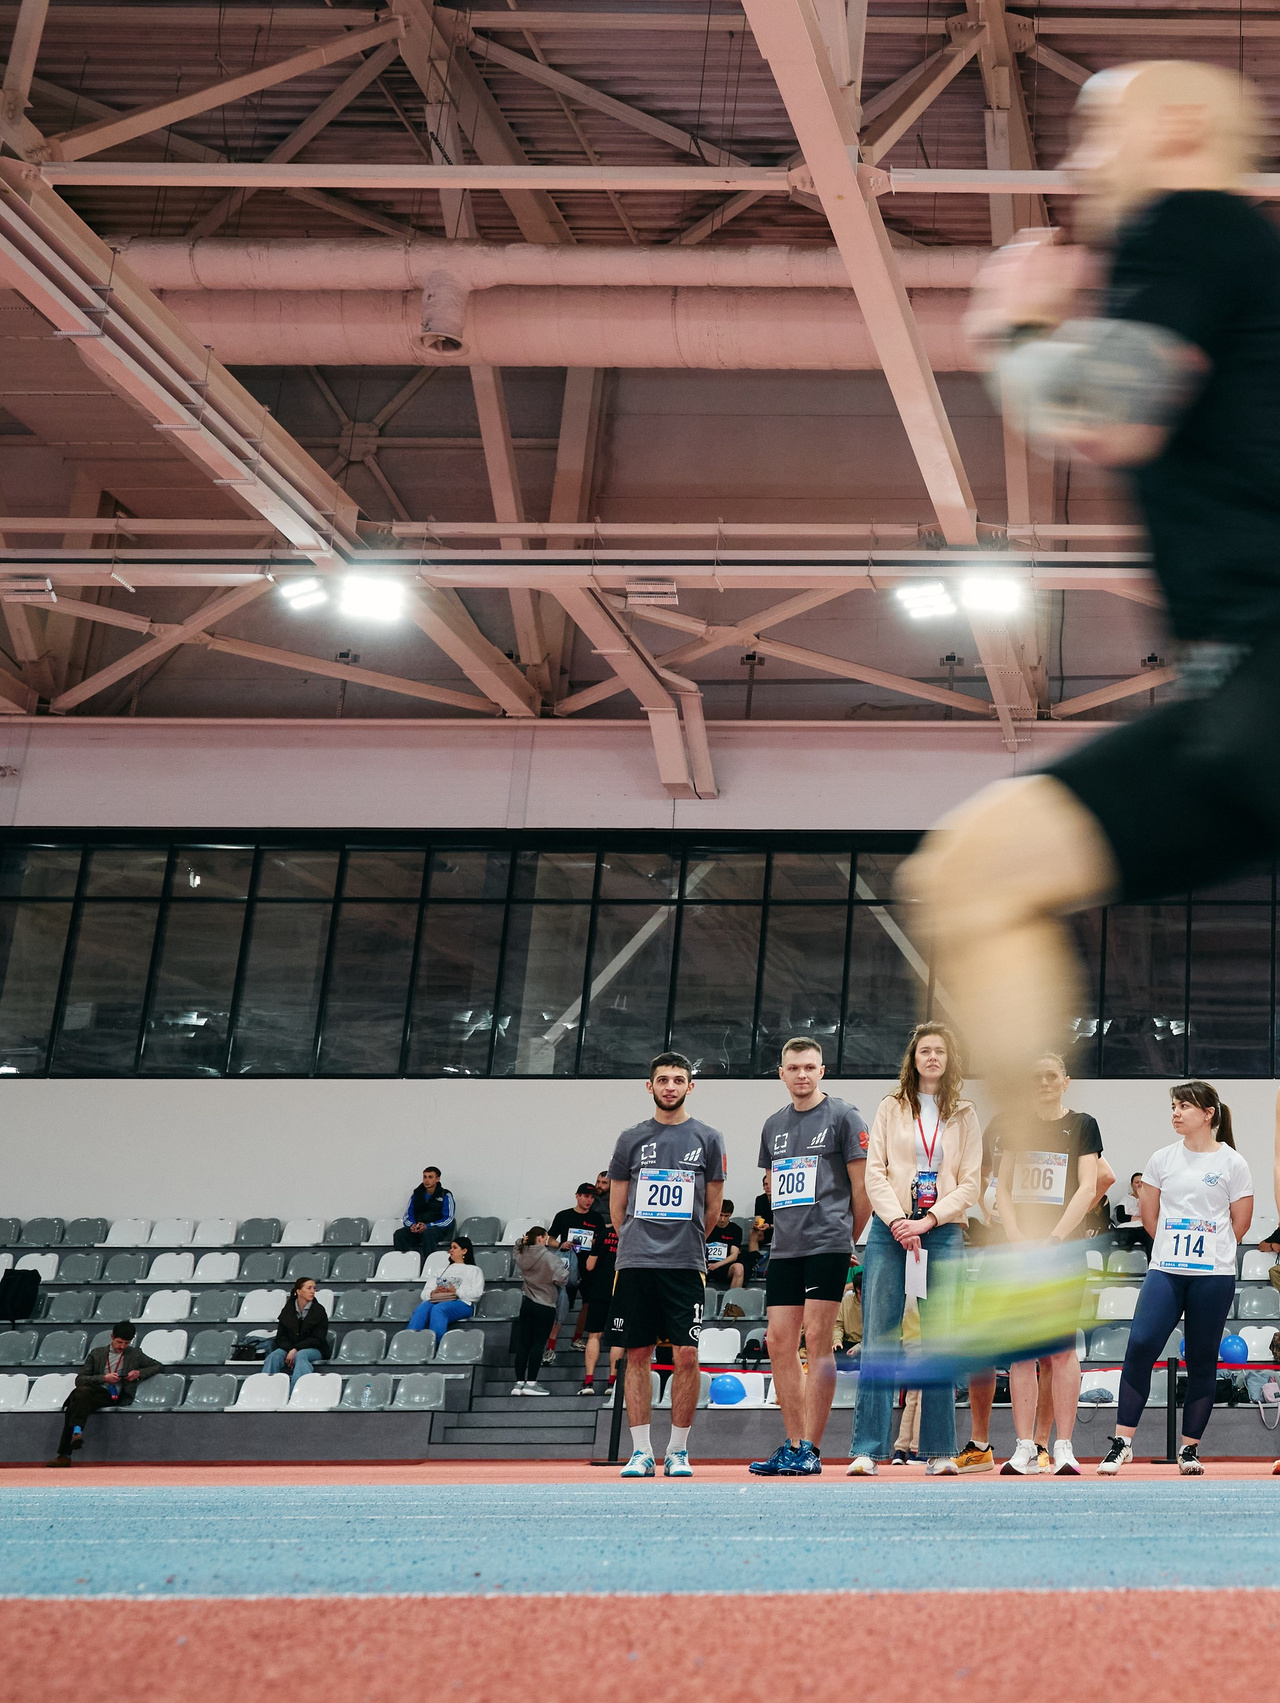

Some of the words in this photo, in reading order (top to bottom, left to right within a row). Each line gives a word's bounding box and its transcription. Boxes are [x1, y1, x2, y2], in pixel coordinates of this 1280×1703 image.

[779, 1172, 805, 1195] 208
[1021, 1167, 1053, 1190] 206
[648, 1184, 682, 1206] 209
[708, 1247, 722, 1256] 225
[1173, 1233, 1204, 1257] 114
